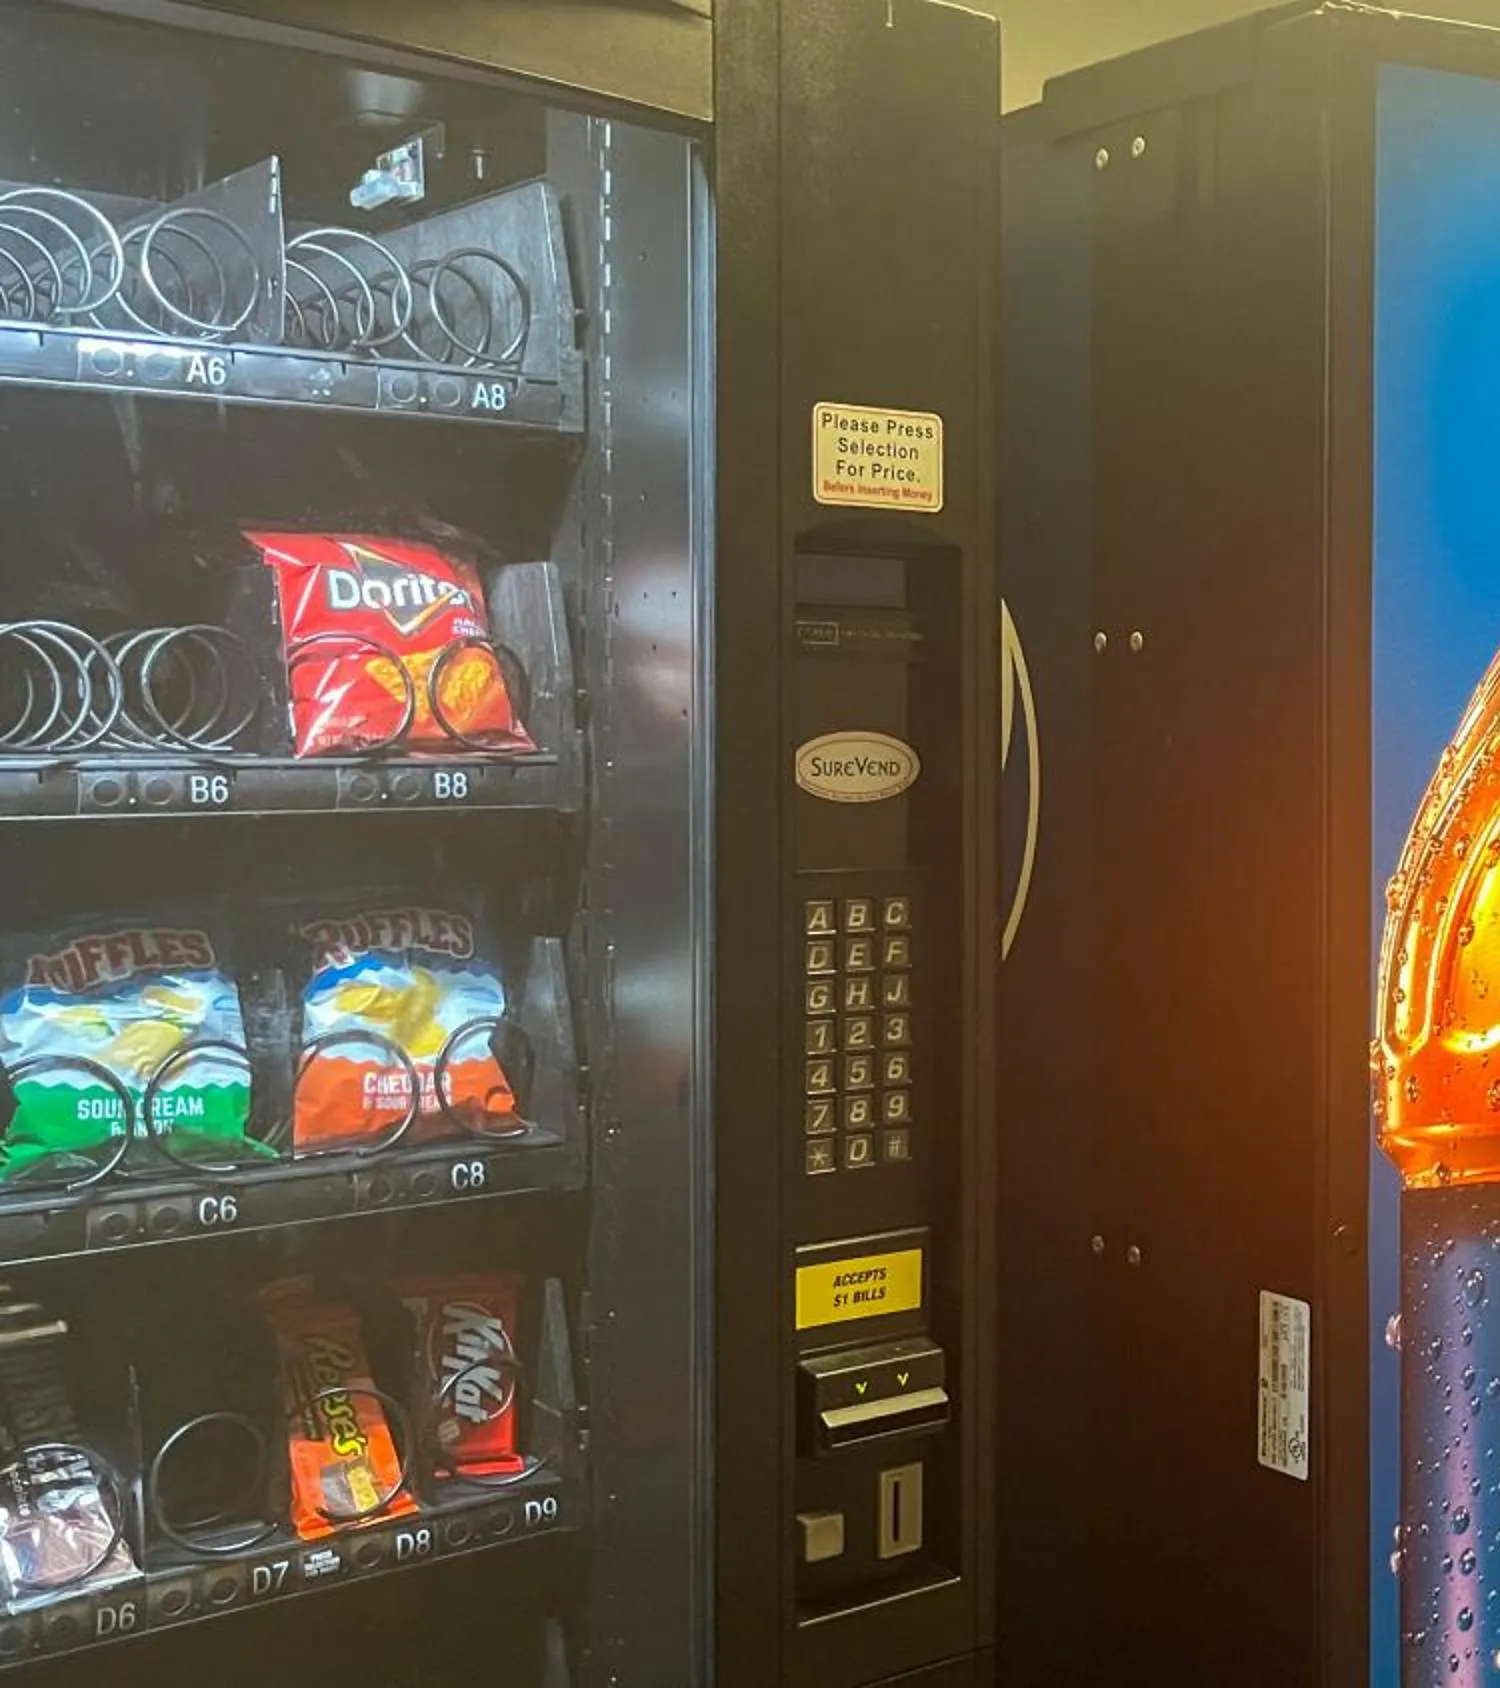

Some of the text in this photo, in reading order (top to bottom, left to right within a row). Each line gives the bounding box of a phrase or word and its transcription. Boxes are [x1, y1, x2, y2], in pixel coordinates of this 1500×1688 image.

[187, 357, 226, 385] A6
[472, 385, 506, 409] A8
[821, 411, 934, 439] Please Press
[837, 437, 919, 460] Selection
[836, 459, 921, 483] For Price.
[823, 480, 933, 503] Before Inserting Money
[328, 569, 474, 613] Dorito
[190, 776, 229, 802] B6
[434, 773, 468, 798] B8
[809, 902, 905, 929] A B C
[809, 942, 902, 969] D E F
[809, 981, 903, 1008] G H J
[814, 1019, 904, 1048] 1 2 3
[811, 1058, 905, 1087] 4 5 6
[812, 1096, 905, 1129] 7 8 9
[451, 1162, 486, 1189] C8
[199, 1196, 238, 1223] C6
[832, 1267, 887, 1288] ACCEPTS
[833, 1286, 887, 1308] $1 BILLS
[525, 1498, 558, 1525] D9
[396, 1529, 433, 1559] D8
[252, 1561, 290, 1594] D7
[96, 1604, 136, 1635] D6
